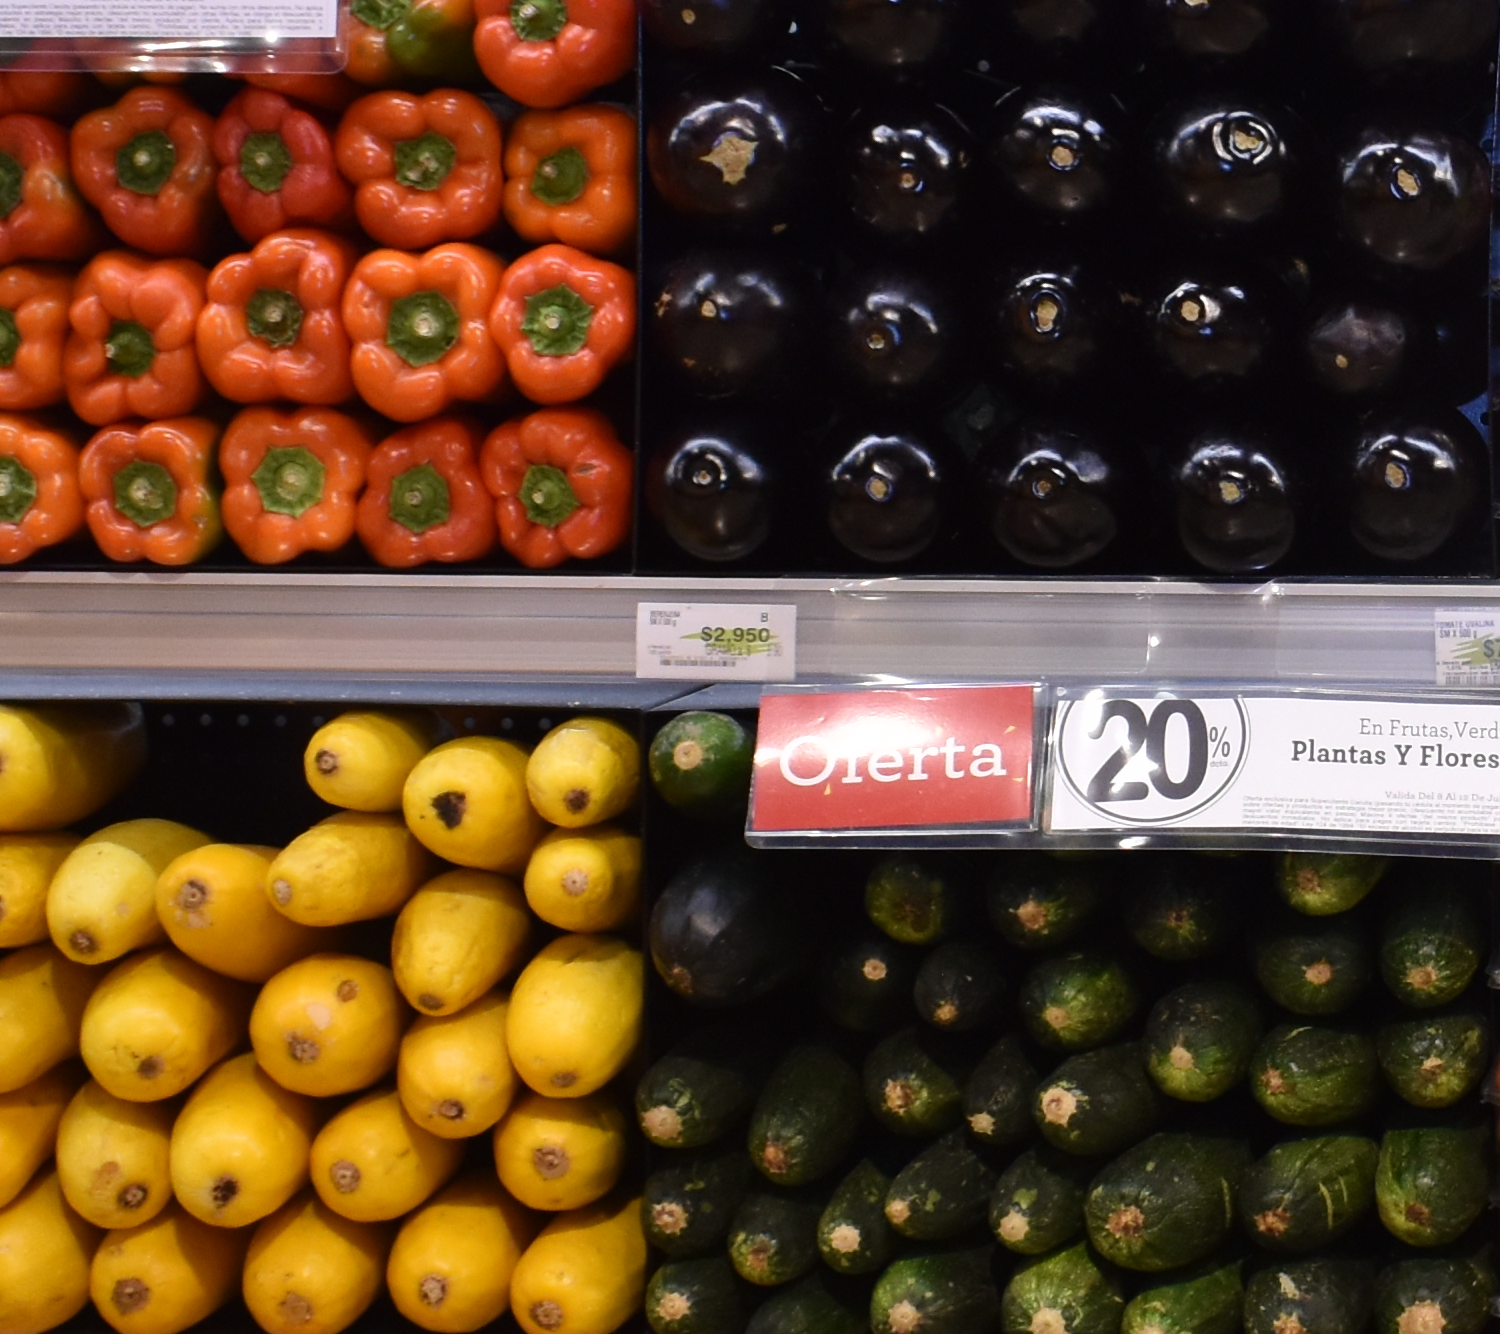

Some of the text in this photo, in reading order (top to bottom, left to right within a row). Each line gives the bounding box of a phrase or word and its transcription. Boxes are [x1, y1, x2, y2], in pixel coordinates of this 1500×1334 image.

[760, 613, 768, 622] B
[701, 627, 770, 643] $2,950
[1359, 718, 1383, 736] En
[1291, 740, 1386, 765] Plantas
[1394, 745, 1412, 766] Y
[1419, 744, 1499, 769] Flores
[1385, 790, 1413, 800] Valida
[1416, 791, 1433, 801] Del
[1437, 791, 1442, 801] 8
[1445, 792, 1455, 802] Al
[1471, 793, 1486, 803] De
